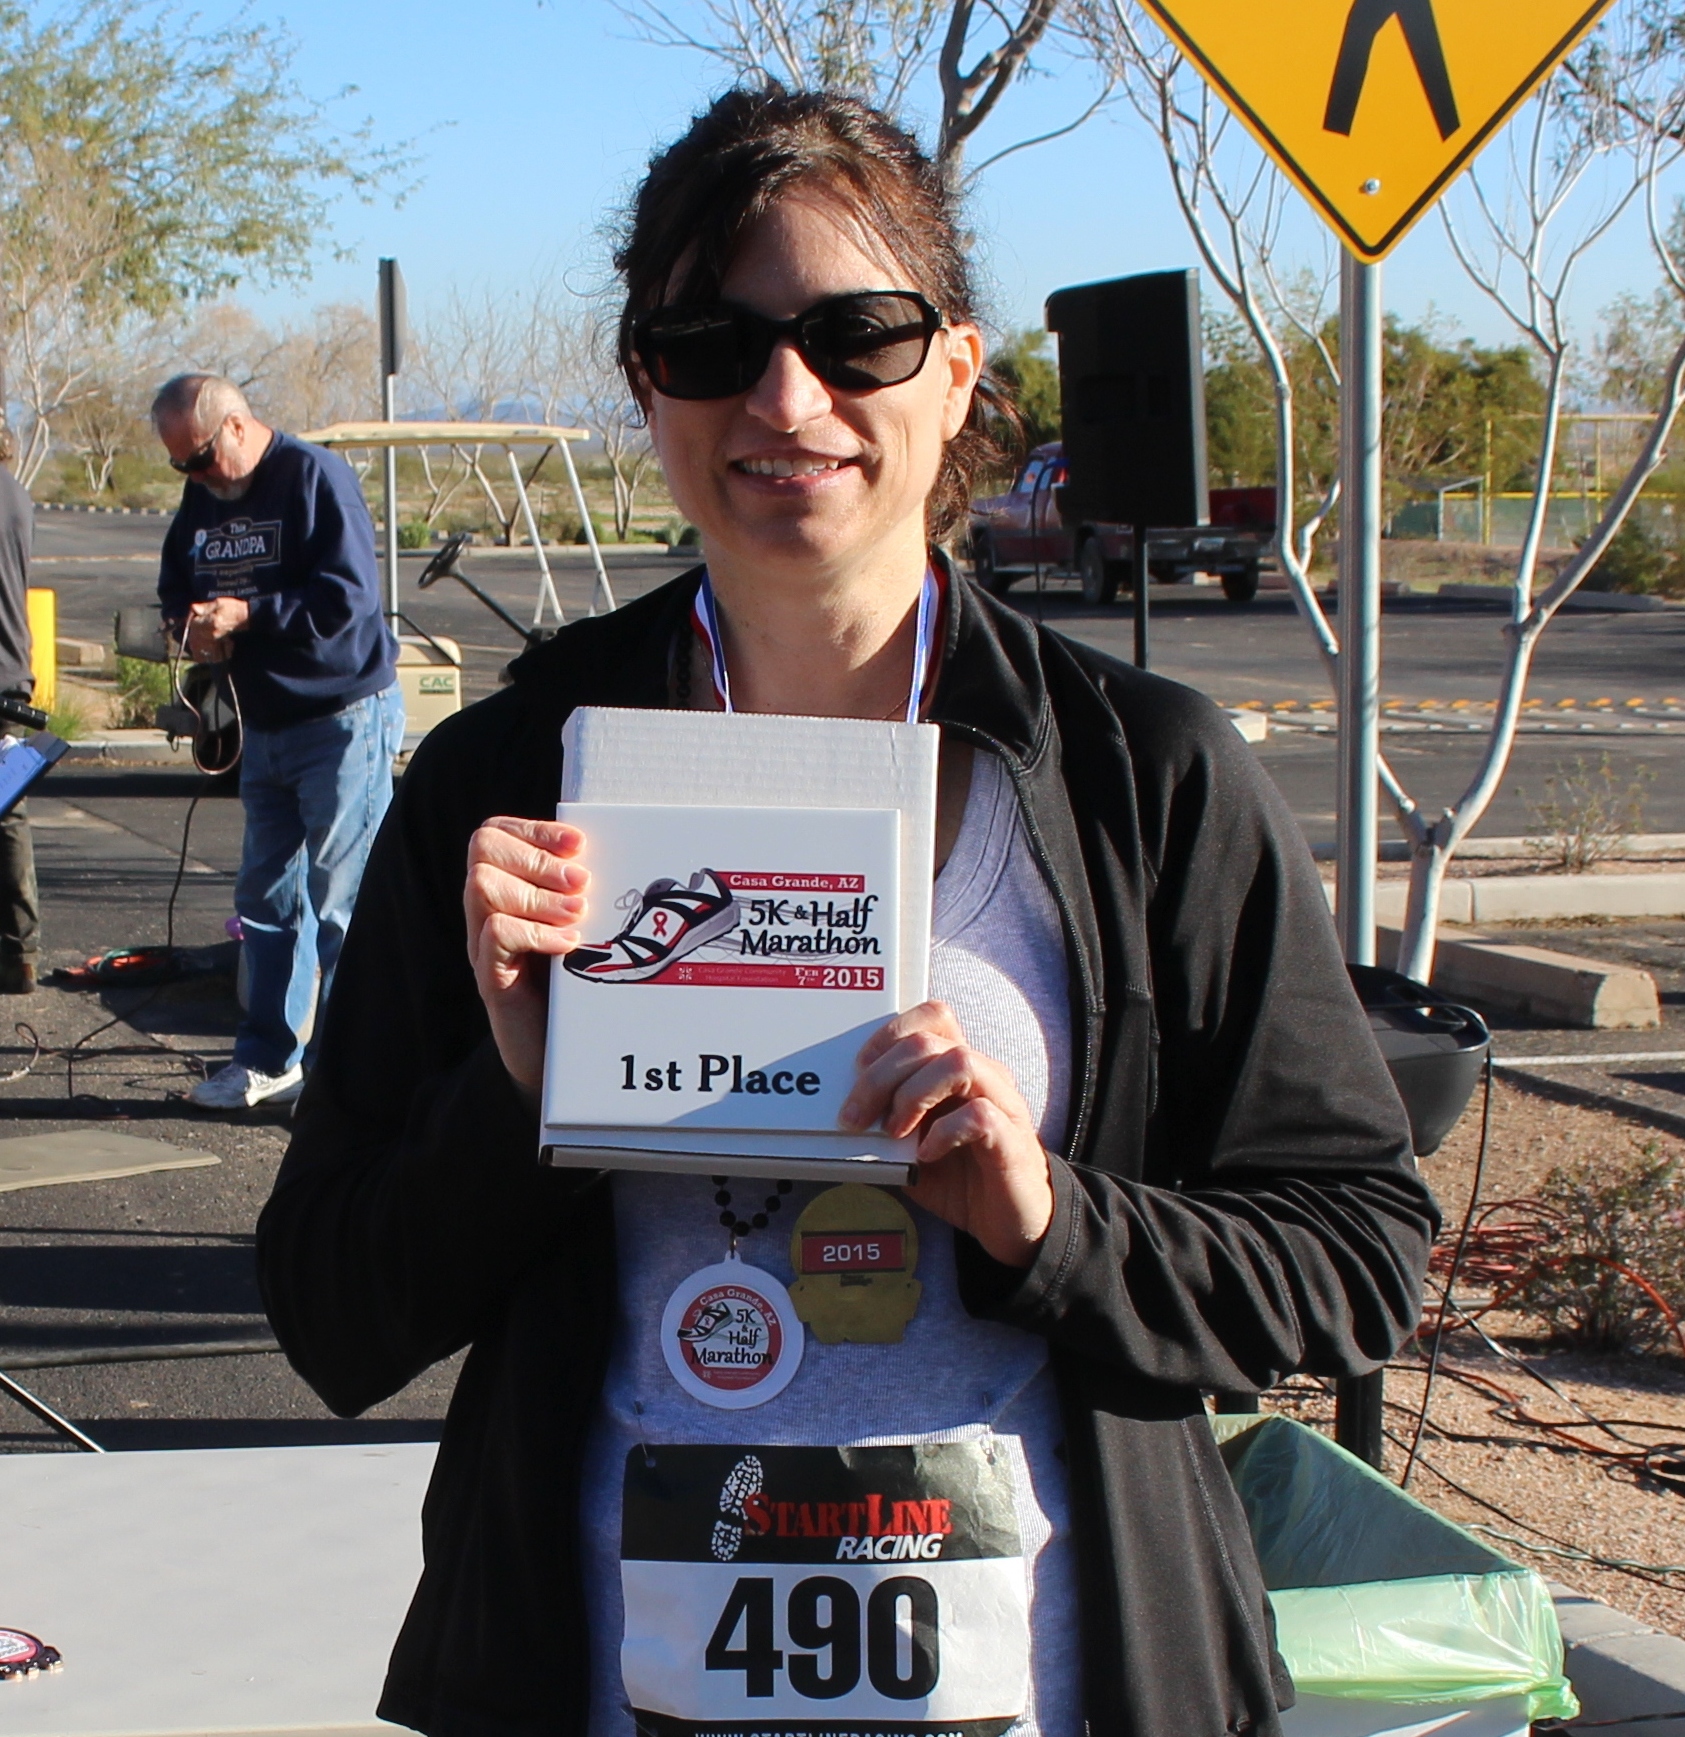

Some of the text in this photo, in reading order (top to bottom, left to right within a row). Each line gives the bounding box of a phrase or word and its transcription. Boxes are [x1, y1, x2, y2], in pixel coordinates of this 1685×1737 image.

[205, 535, 266, 560] GRANDPA
[419, 676, 453, 688] CAC
[729, 874, 860, 890] Casa Grande, AZ
[748, 894, 879, 935] 5K & Half
[739, 928, 881, 956] Marathon
[822, 967, 880, 988] 2015
[620, 1054, 821, 1096] 1st Place
[822, 1243, 880, 1262] 2015
[699, 1290, 725, 1306] Casa
[763, 1310, 777, 1327] AZ
[735, 1308, 756, 1324] 5K
[728, 1327, 762, 1349] Half
[690, 1346, 774, 1366] Marathon
[835, 1532, 944, 1561] RACING
[704, 1575, 940, 1700] 490
